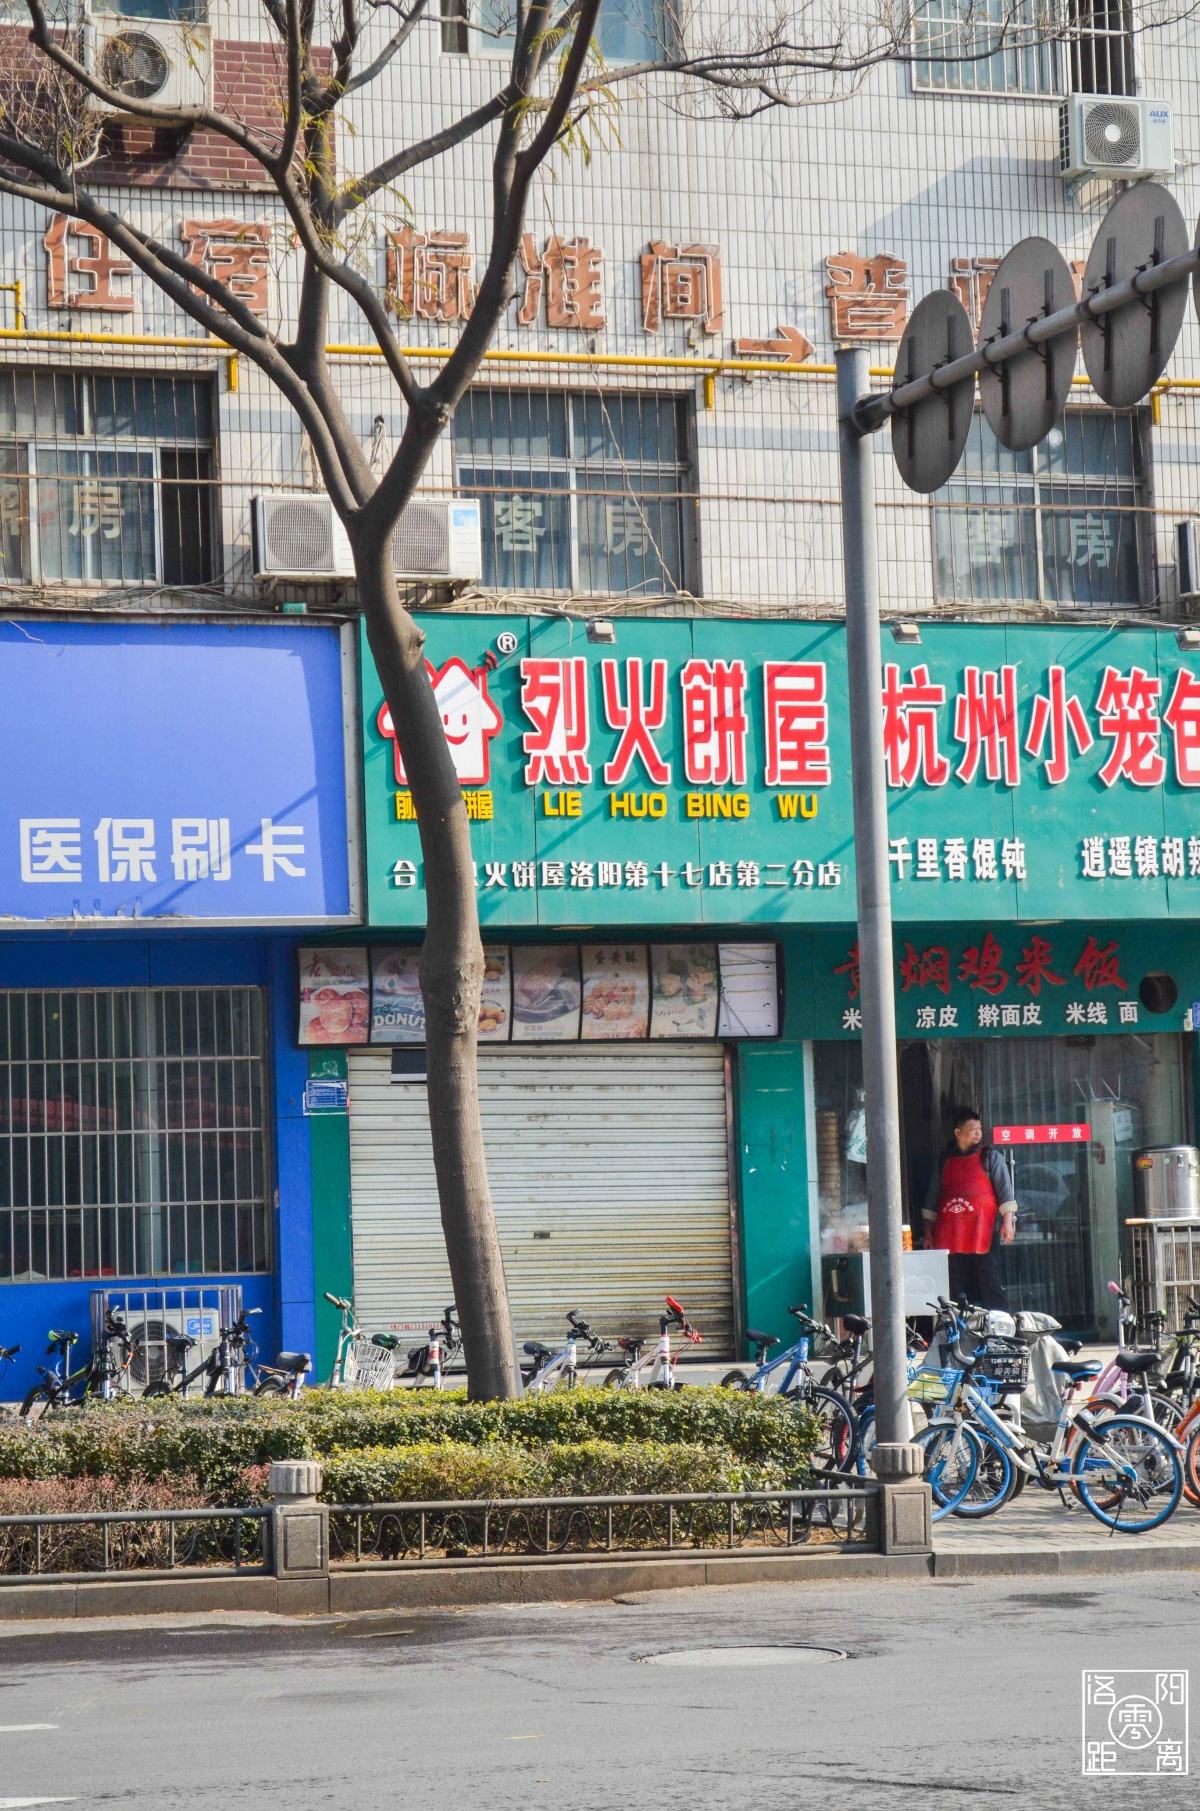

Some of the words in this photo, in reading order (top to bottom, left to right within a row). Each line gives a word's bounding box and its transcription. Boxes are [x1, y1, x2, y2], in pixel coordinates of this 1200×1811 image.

[1150, 110, 1169, 118] AUX
[493, 495, 652, 557] 客房
[543, 791, 583, 817] LIE
[611, 792, 668, 818] HUO
[687, 793, 750, 819] BING
[778, 794, 818, 819] WU
[19, 817, 306, 883] 医保刷卡
[392, 860, 842, 889] 合火饼屋洛阳第十七店第二分店
[916, 1005, 959, 1029] 凉皮
[978, 1002, 1042, 1028] 擀面皮
[1066, 1001, 1108, 1026] 米线
[1118, 1001, 1139, 1024] 面
[1001, 1127, 1082, 1141] 空调开放
